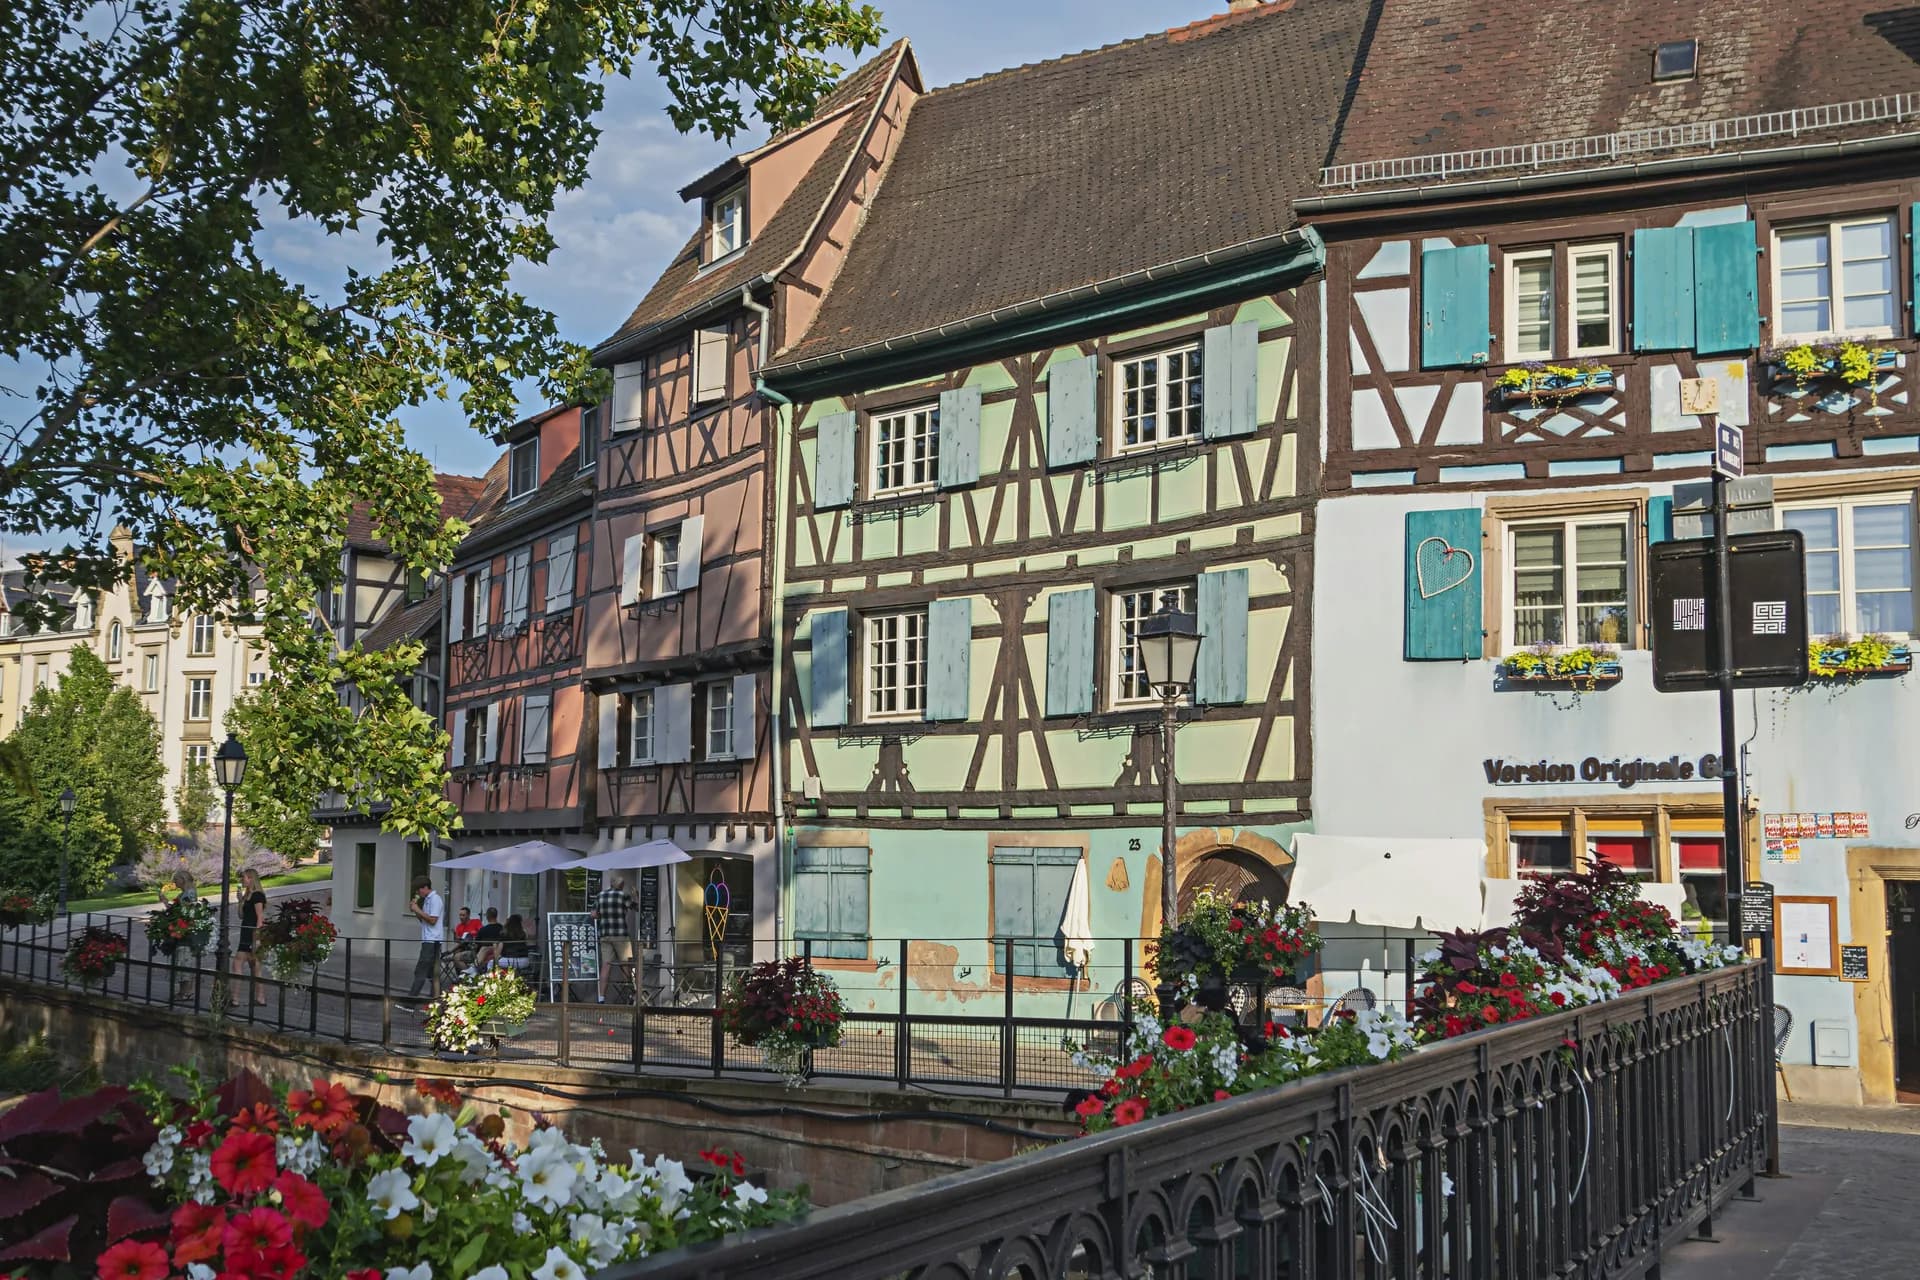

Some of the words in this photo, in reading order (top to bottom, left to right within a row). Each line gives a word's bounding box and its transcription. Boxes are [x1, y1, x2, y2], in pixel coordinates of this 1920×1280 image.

[1483, 758, 1575, 784] Version
[1580, 755, 1694, 789] Originale
[1128, 838, 1141, 851] 23
